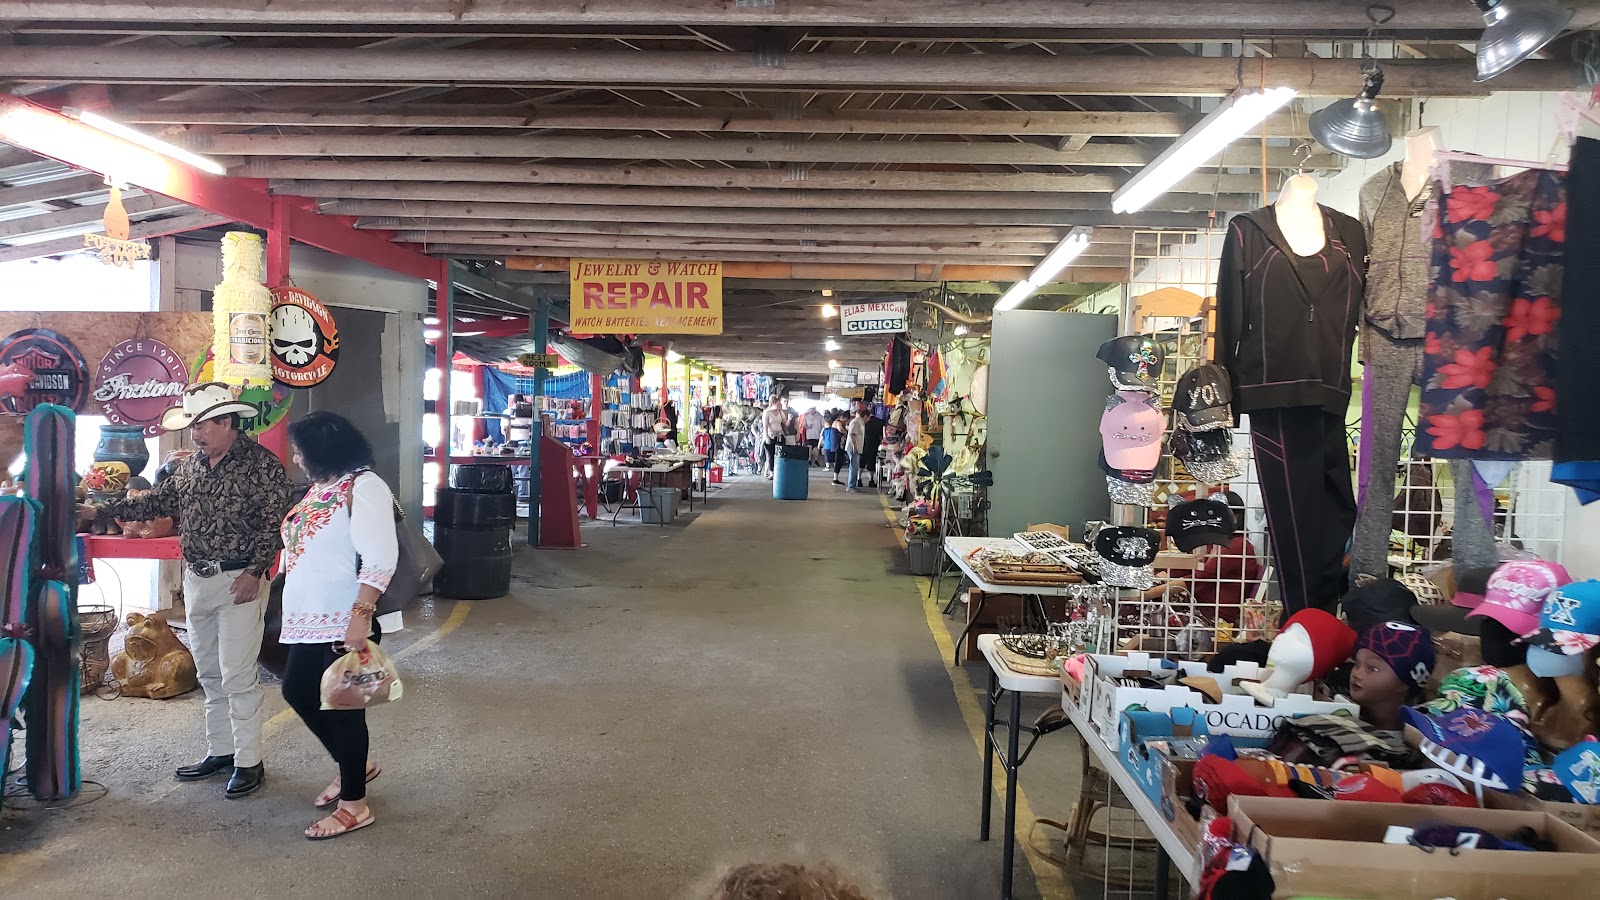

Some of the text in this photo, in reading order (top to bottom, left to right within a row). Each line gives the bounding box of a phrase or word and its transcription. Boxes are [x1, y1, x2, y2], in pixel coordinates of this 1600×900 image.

[82, 232, 151, 258] POTTERY
[100, 247, 134, 269] GUY
[574, 261, 718, 281] JEWELRY & WATCH
[583, 281, 709, 309] REPAIR
[575, 316, 602, 327] WATCH
[605, 316, 649, 327] BATTERIES
[844, 302, 904, 317] ELIAS MEXICAN
[848, 320, 902, 331] CURIOS
[104, 343, 179, 372] SINCE 1901
[93, 373, 184, 401] Indian
[1187, 382, 1223, 410] YO!
